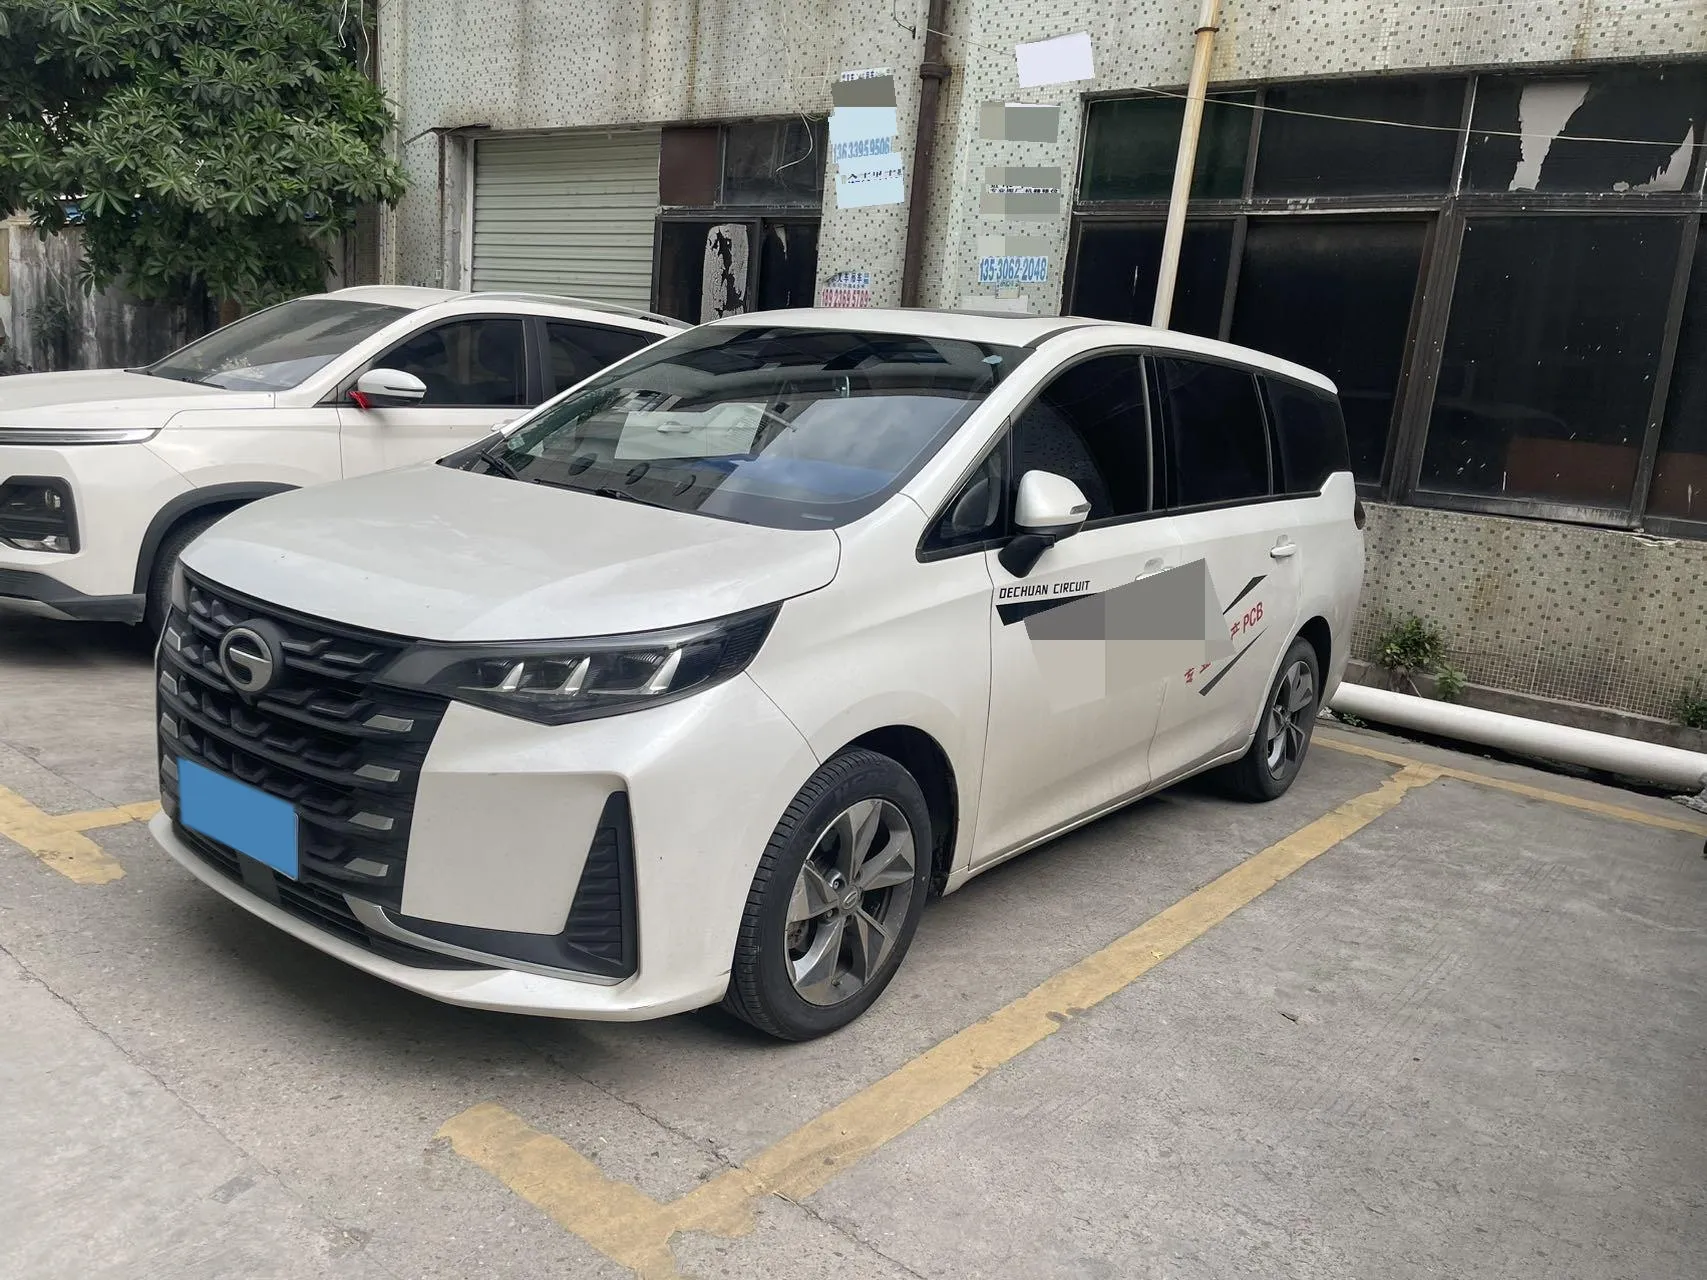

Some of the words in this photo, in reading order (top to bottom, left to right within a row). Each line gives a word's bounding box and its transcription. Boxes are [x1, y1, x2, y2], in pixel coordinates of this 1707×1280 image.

[980, 257, 1048, 281] 135-3062-2048
[999, 584, 1049, 599] DECHUAN
[1053, 580, 1091, 595] CIRCUIT
[1243, 601, 1264, 634] PCB
